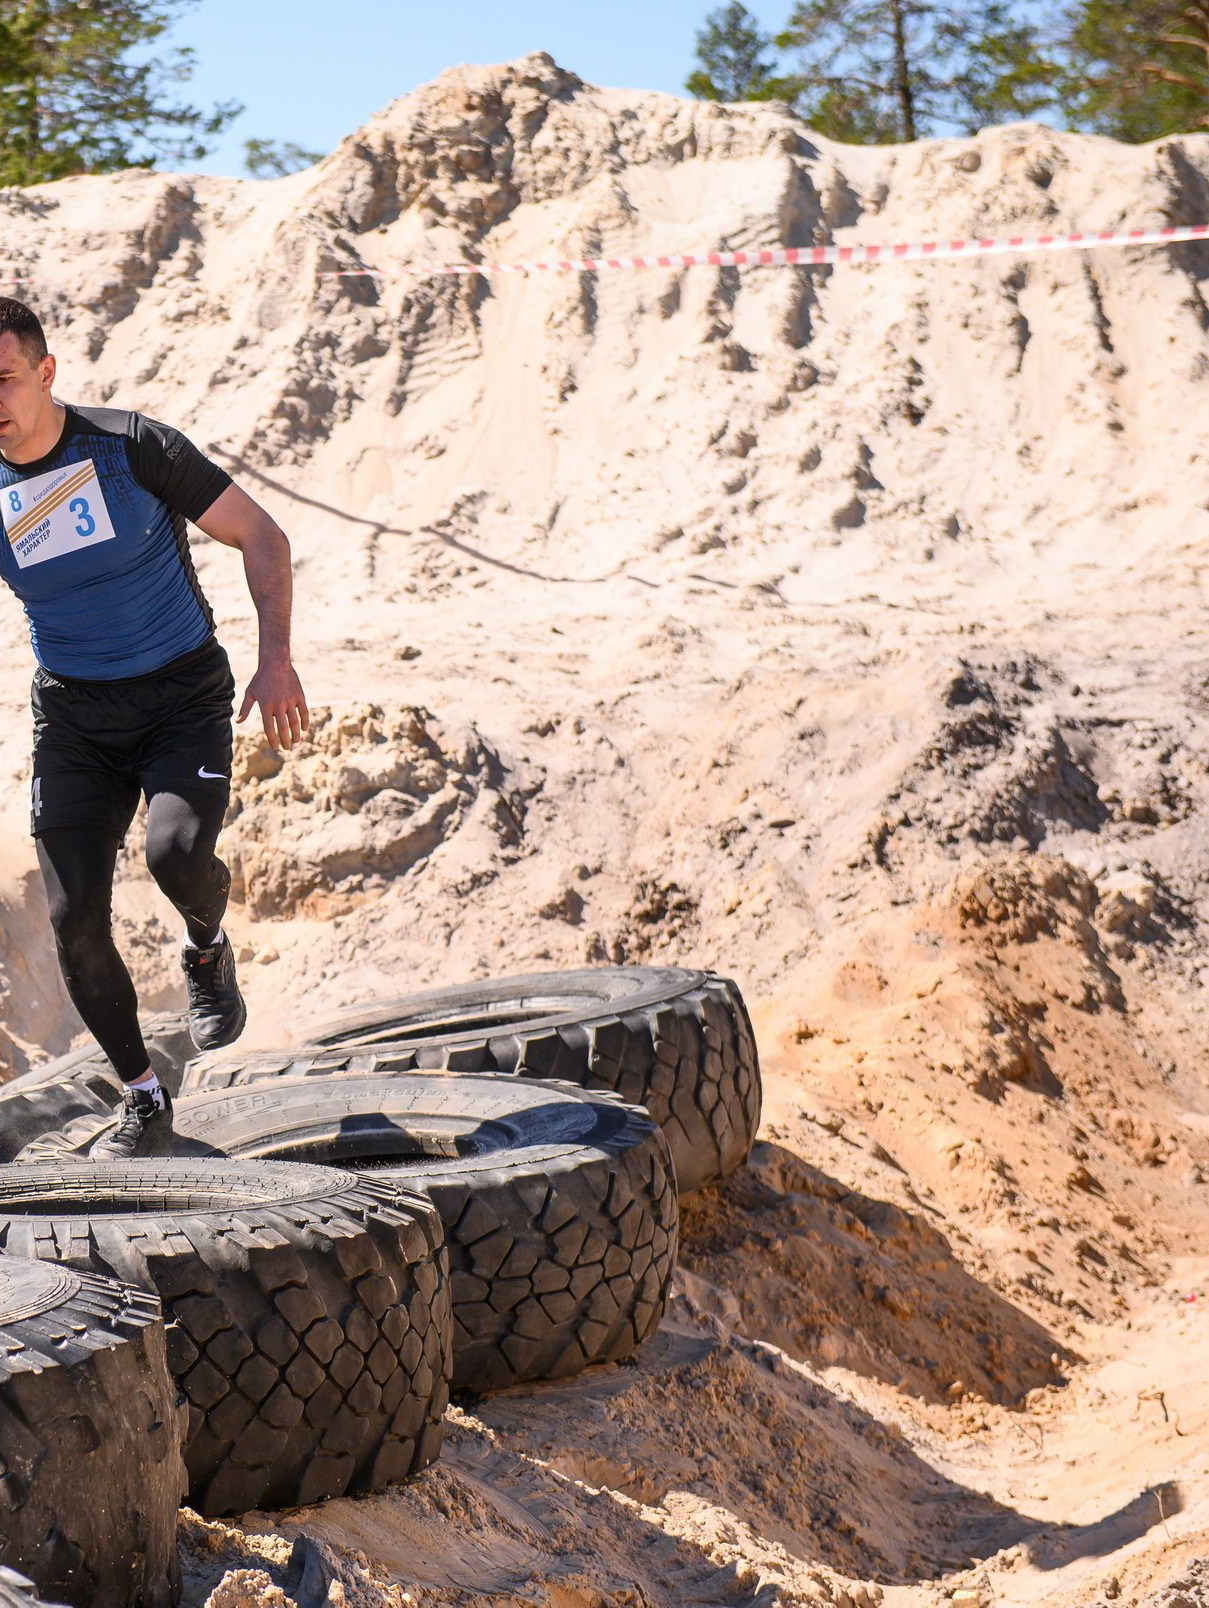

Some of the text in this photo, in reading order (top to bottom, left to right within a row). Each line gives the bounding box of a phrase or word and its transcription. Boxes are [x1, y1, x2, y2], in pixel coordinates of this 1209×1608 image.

[8, 490, 23, 512] 8
[68, 497, 96, 537] 3
[16, 518, 50, 553] ЯМАЛЬСКИЙ
[22, 529, 50, 558] ХАРАКТЕР
[178, 1095, 266, 1132] POWER
